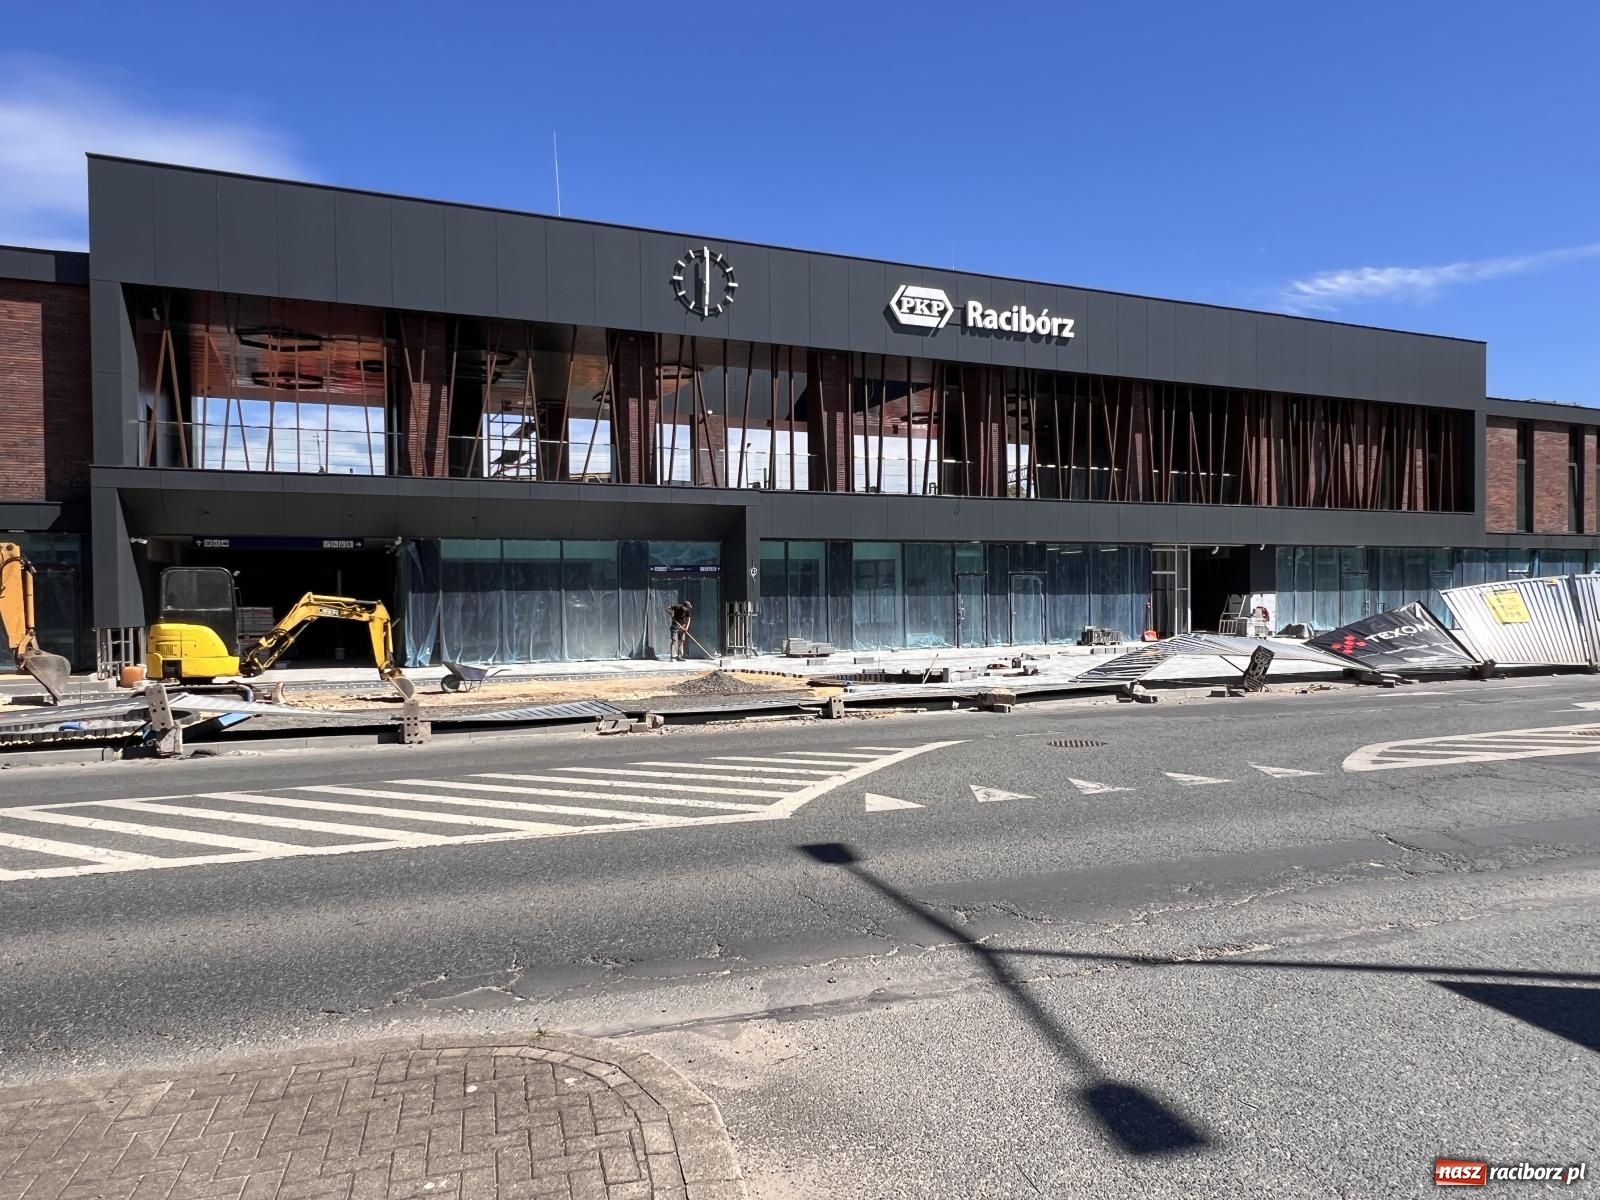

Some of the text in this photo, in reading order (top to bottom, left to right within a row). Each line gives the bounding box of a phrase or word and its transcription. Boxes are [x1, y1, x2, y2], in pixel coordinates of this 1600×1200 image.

[899, 297, 1075, 339] PKP Racibórz
[1364, 621, 1437, 643] TEXOM
